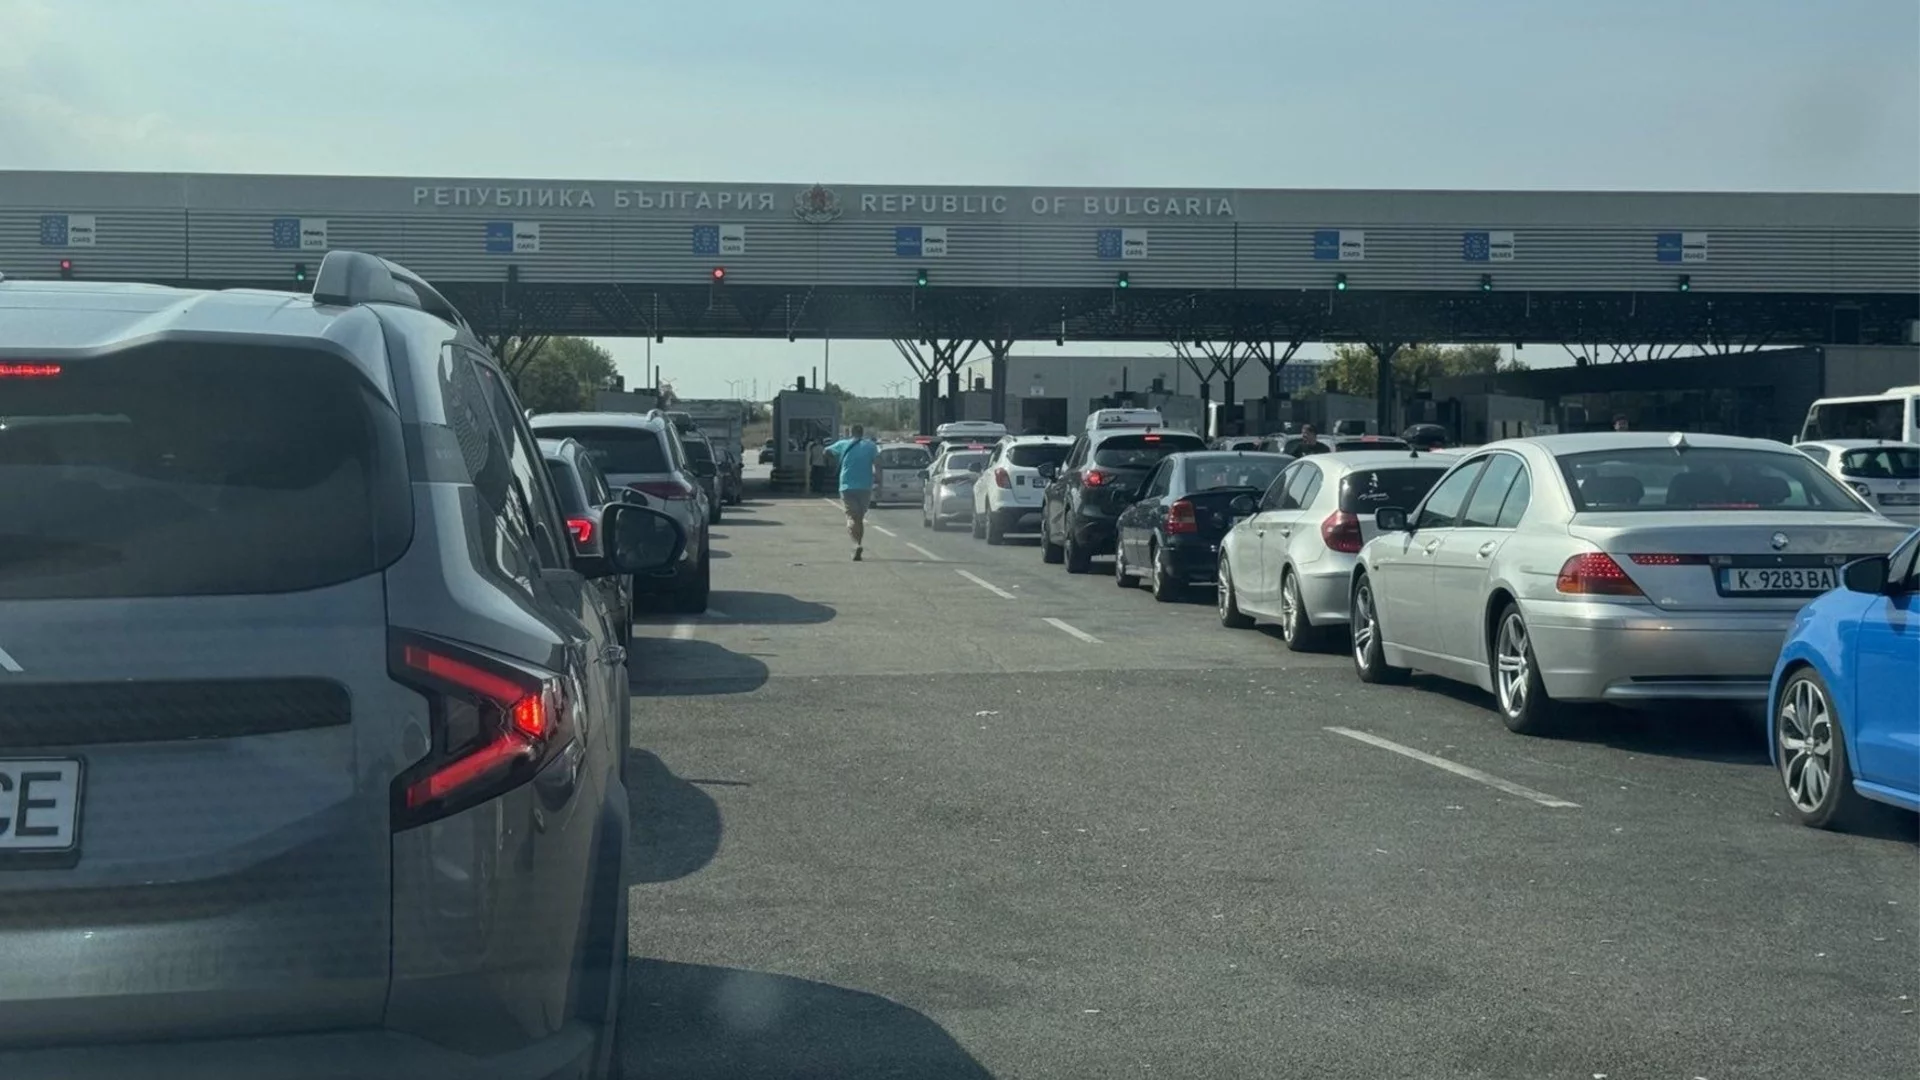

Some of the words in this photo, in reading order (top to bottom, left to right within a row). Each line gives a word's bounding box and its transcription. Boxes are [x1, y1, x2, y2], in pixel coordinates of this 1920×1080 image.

[413, 186, 596, 208] РЕПУБЛИКА
[614, 189, 775, 210] БЪЛГАРИЯ
[861, 193, 1007, 214] REPUBLIC
[1031, 196, 1066, 214] OF
[1084, 196, 1234, 216] BULGARIA
[1738, 570, 1750, 588] K
[0, 771, 62, 837] E
